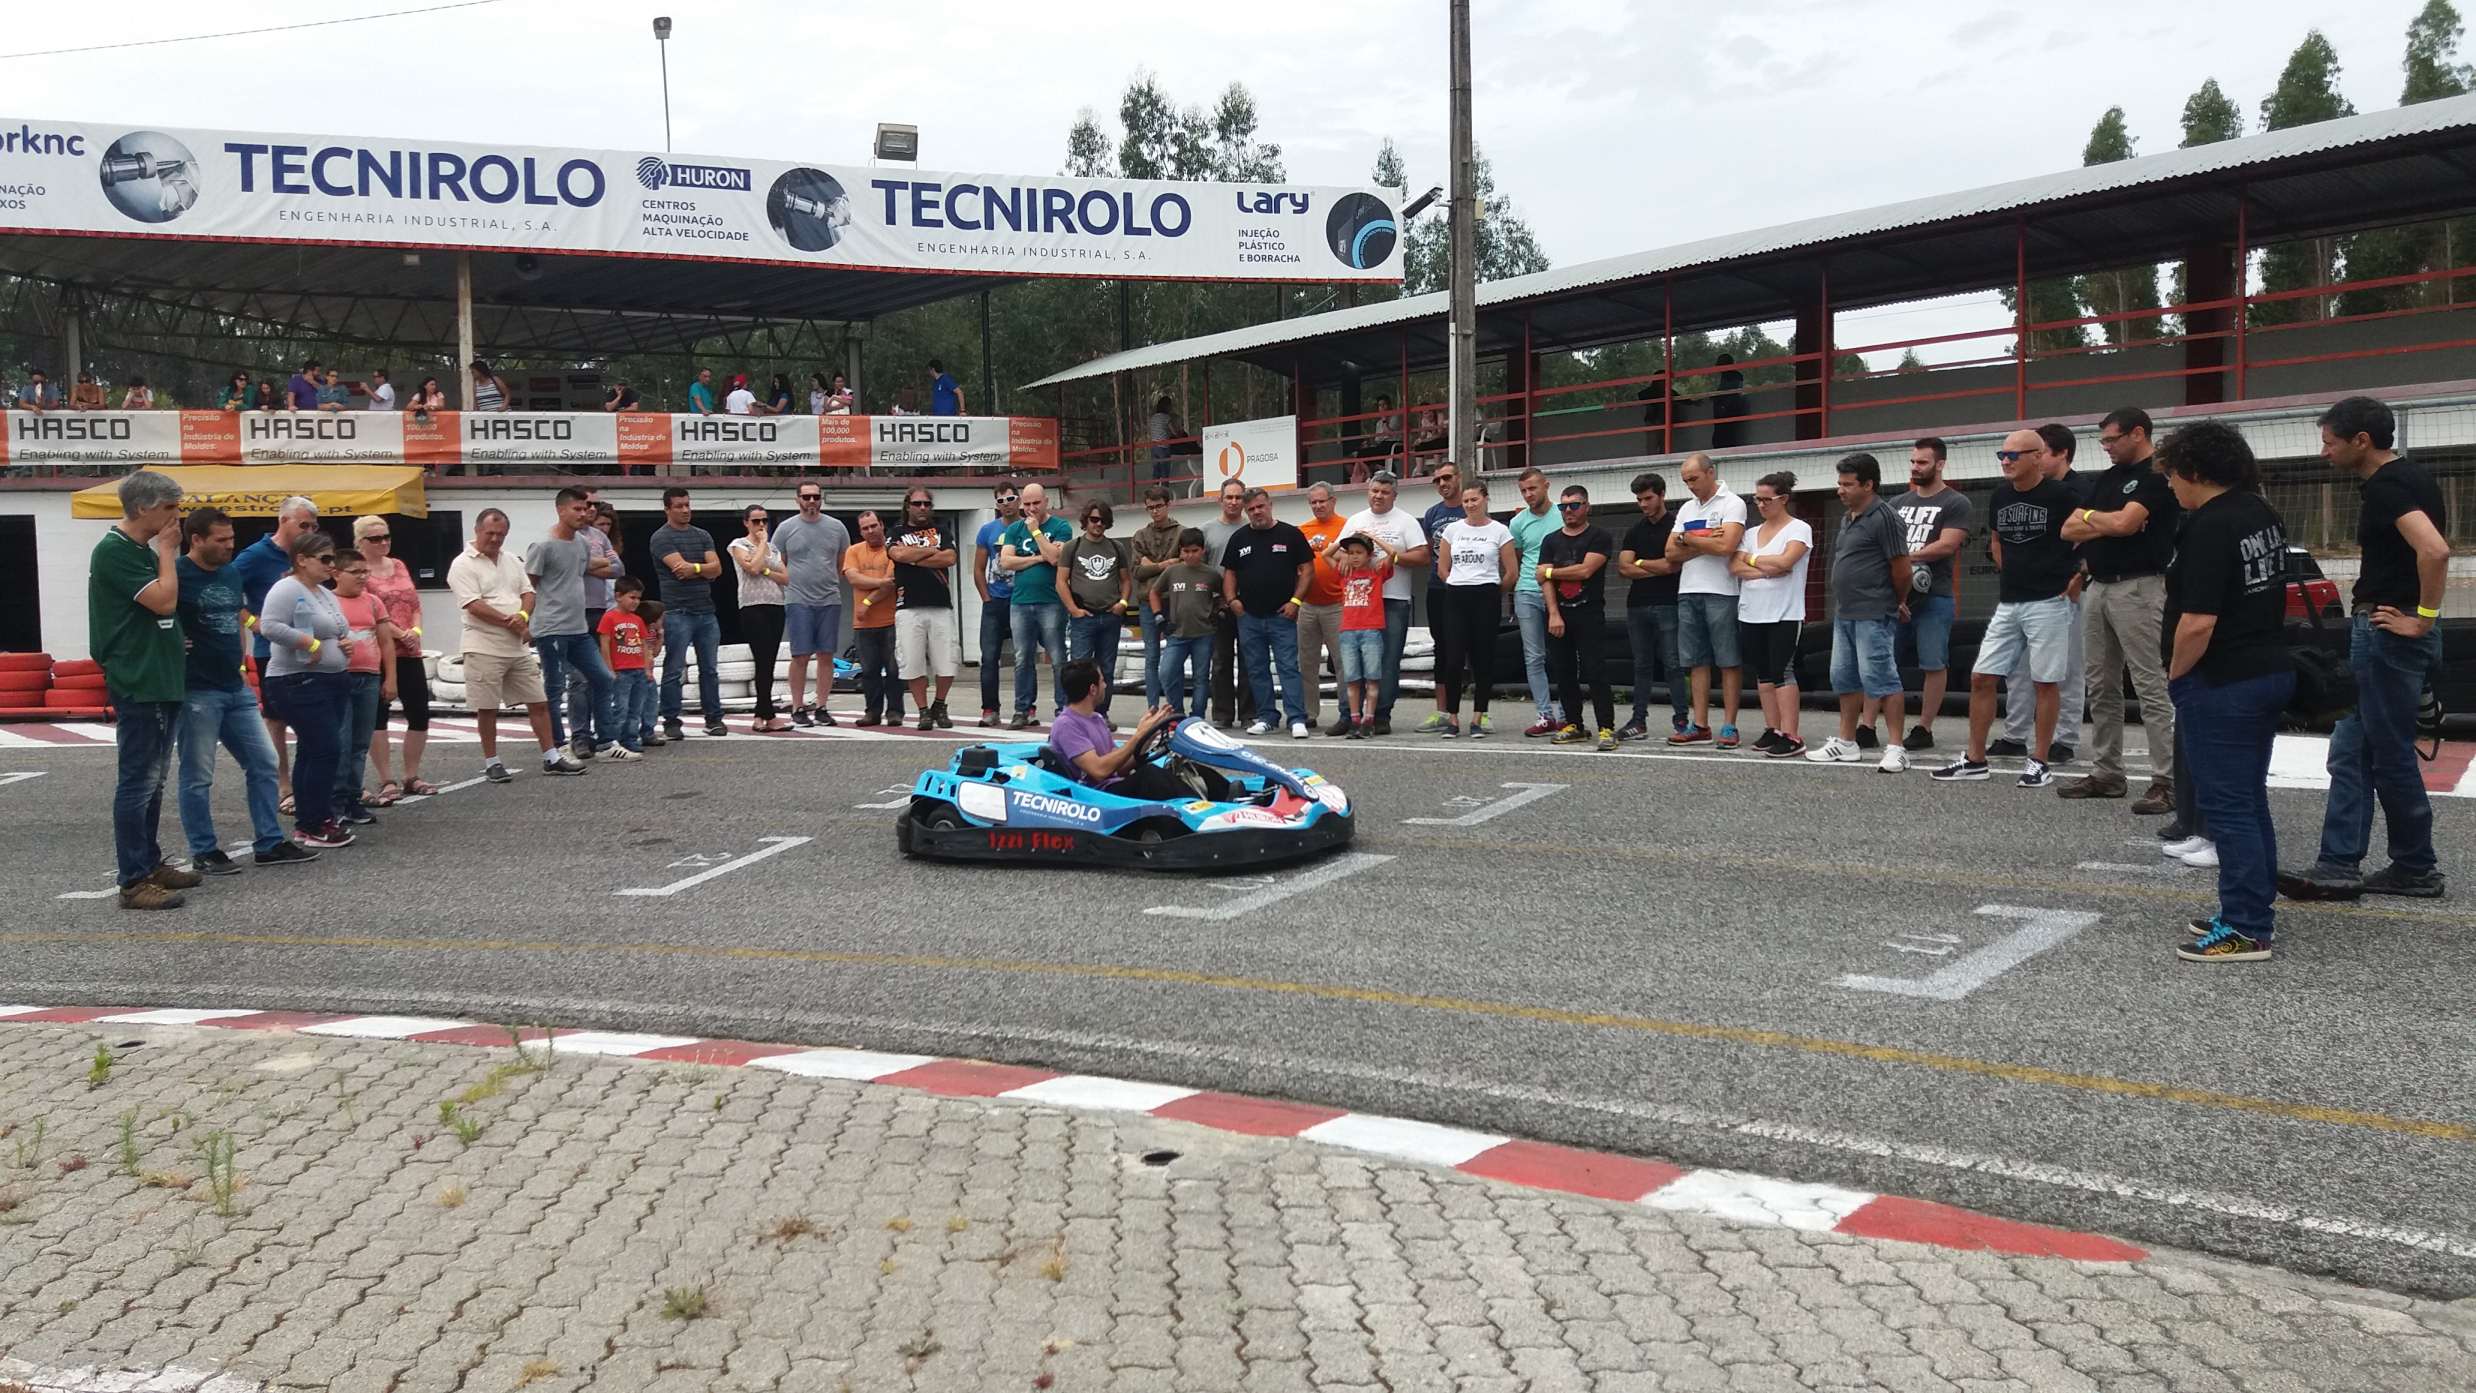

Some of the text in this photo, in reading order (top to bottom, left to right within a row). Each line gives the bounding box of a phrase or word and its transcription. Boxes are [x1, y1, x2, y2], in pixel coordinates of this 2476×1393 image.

[0, 124, 86, 156] rknc
[224, 142, 606, 208] TECNIROLO
[677, 167, 745, 188] HURON
[642, 199, 696, 211] CENTROS
[871, 179, 1192, 238] TECNIROLO
[279, 210, 558, 232] ENGENHARIA INDUSTRIAL, S.A.
[642, 213, 724, 227] MAQUINAÇÃO
[642, 227, 749, 241] ALTA VELOCIDADE
[1238, 227, 1280, 240] INJEÇÃO
[917, 242, 1152, 261] ENGENHARIA INDUSTRIAL, S.A.
[1238, 240, 1285, 251] PLÁSTICO
[1239, 254, 1301, 263] E BORRACHA
[18, 418, 130, 440] HASCO
[250, 418, 356, 440] HASCO
[821, 418, 850, 426] Mais de
[470, 419, 572, 440] HASCO
[681, 421, 776, 442] HASCO
[880, 423, 969, 443] HASCO
[821, 435, 856, 444] produtos.
[19, 449, 80, 461] Enabling
[85, 450, 113, 460] with
[251, 448, 309, 461] Enabling
[313, 450, 341, 460] with
[471, 448, 527, 461] Enabling
[531, 449, 557, 460] with
[682, 449, 813, 463] Enabling with System.
[880, 450, 930, 463] Enabling
[933, 450, 955, 462] with
[1246, 453, 1279, 464] PRAGOSA
[1898, 506, 1942, 525] #LIFT
[1013, 791, 1101, 822] TECNIROLO
